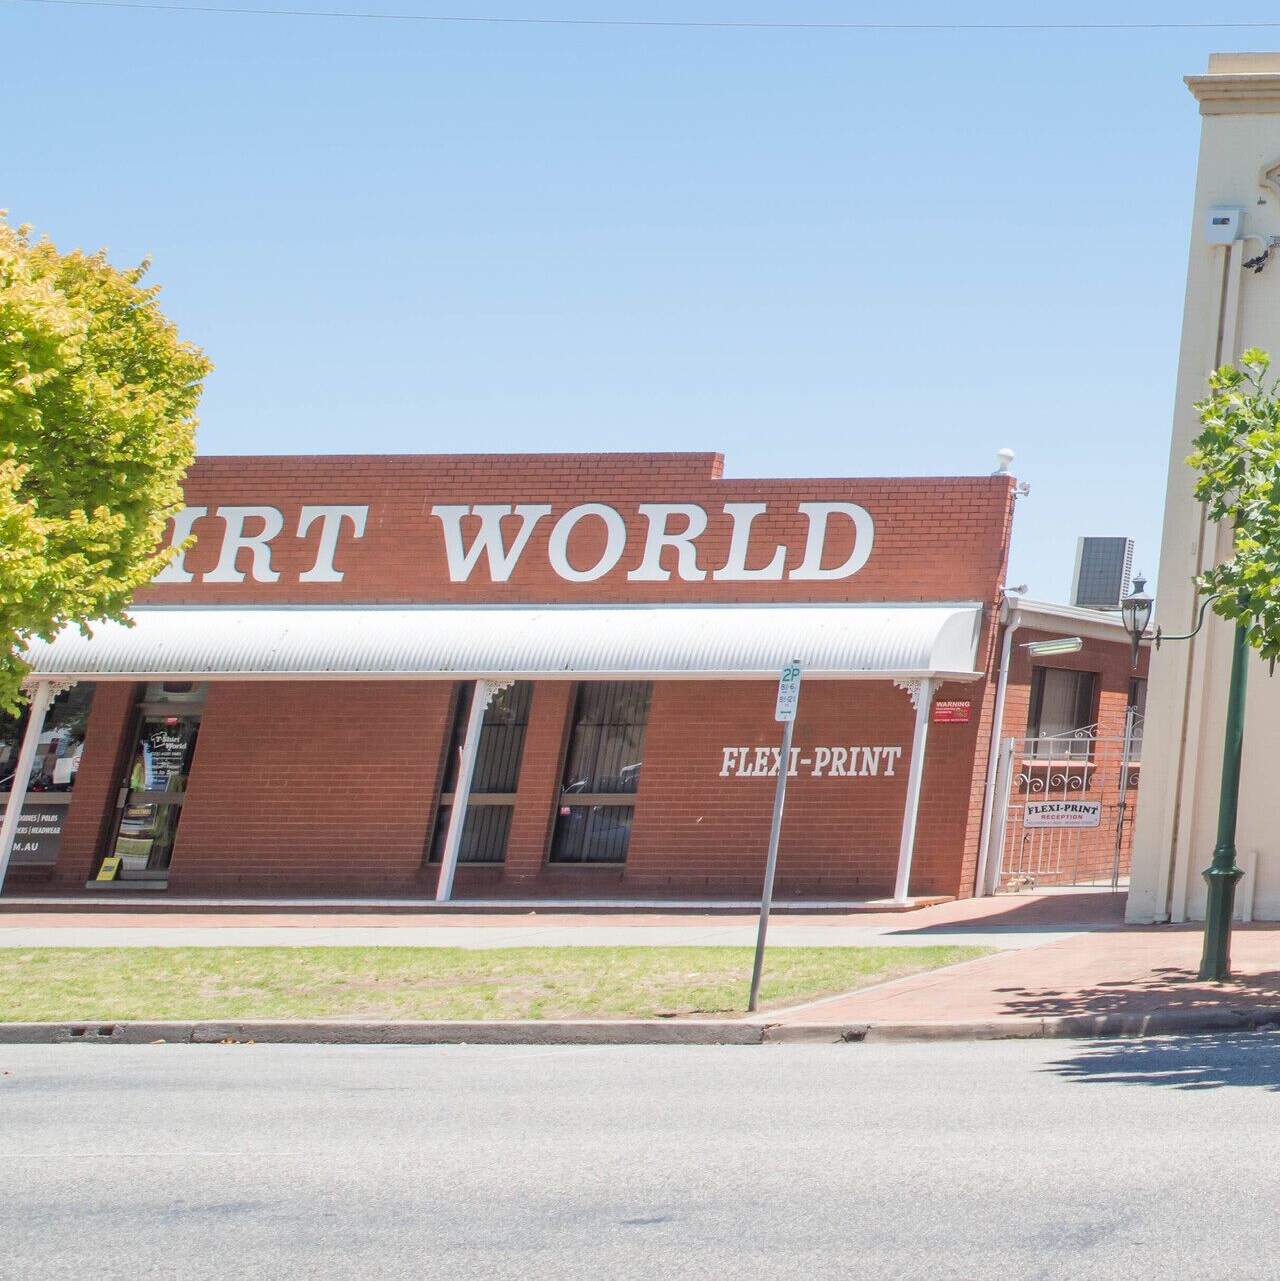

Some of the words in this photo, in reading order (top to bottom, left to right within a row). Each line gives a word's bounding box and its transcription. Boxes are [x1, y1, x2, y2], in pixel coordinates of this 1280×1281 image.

[151, 504, 370, 583] IRT
[430, 502, 876, 583] WORLD
[782, 668, 800, 682] 2P
[719, 747, 902, 777] FLEXI-PRINT
[1028, 804, 1099, 815] FLEXI-PRINT
[12, 842, 39, 850] M.AU
